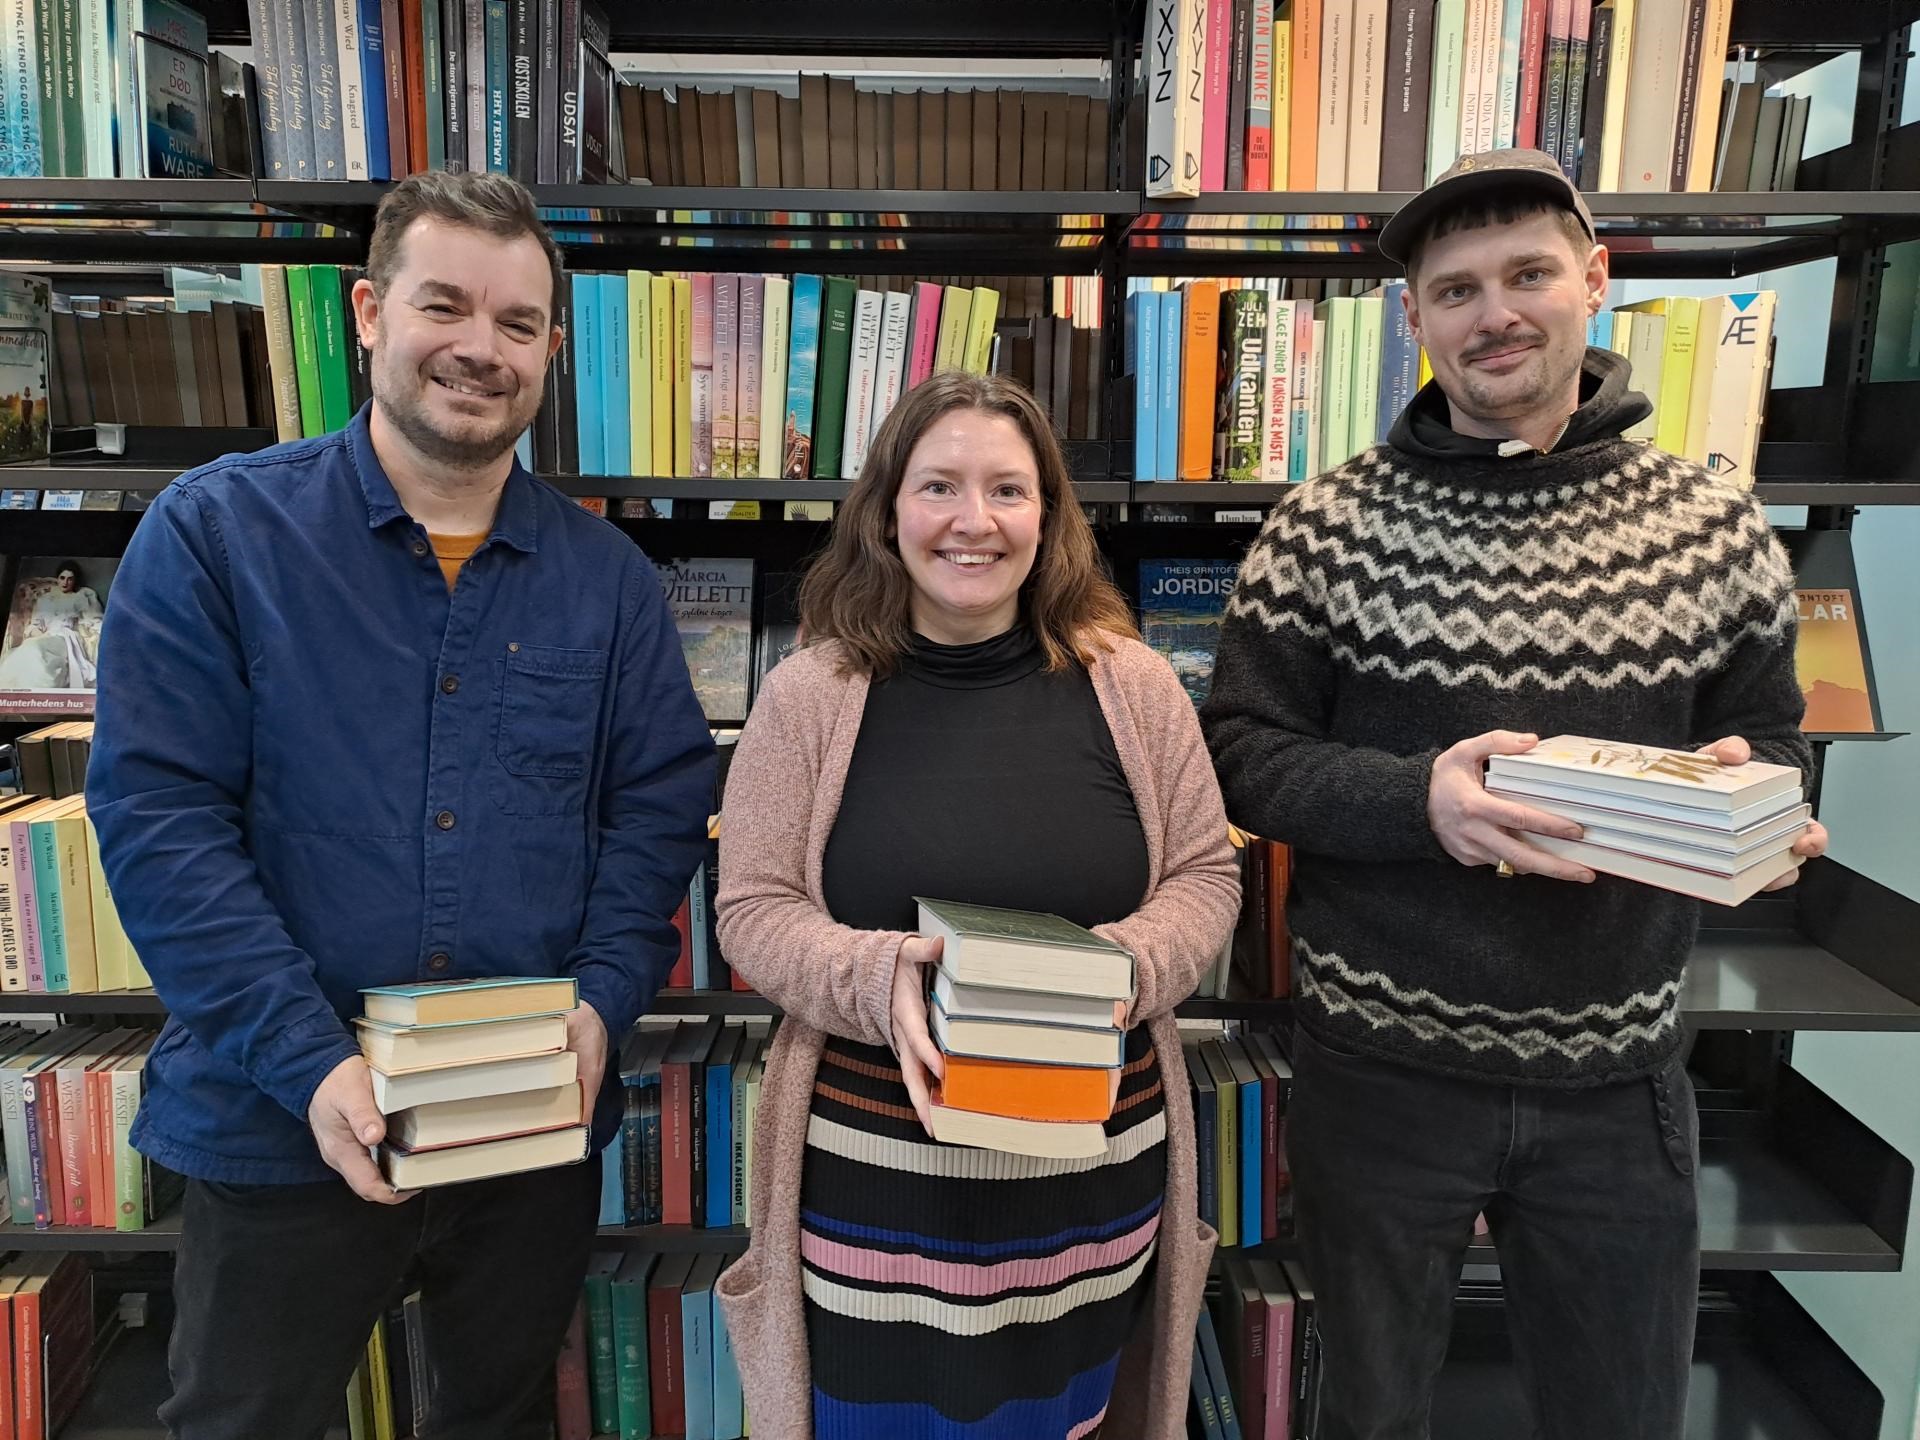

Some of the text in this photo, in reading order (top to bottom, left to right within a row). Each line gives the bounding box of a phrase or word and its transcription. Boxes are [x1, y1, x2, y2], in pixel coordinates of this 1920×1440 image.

[1332, 14, 1341, 35] Hanya
[1366, 14, 1375, 35] Hanya
[1406, 8, 1416, 32] Hanya
[1530, 11, 1540, 45] Samantha
[17, 30, 27, 73] LEVENDE
[173, 58, 186, 74] ER
[1254, 6, 1271, 101] YAN LIANKE
[1404, 33, 1414, 74] Yanagihara:
[20, 76, 28, 91] OG
[169, 75, 191, 94] DØD
[344, 24, 360, 130] Wied Knagsted
[515, 27, 530, 119] WIK KOSTSKOLEN
[1463, 44, 1479, 123] YOUNG INDIA
[1480, 44, 1495, 123] YOUNG INDIA
[1526, 70, 1535, 95] London
[1683, 77, 1692, 103] dengang
[286, 86, 305, 131] hjerteslag
[314, 86, 335, 131] hjerteslag
[448, 51, 459, 133] De store stjerners tid
[1402, 86, 1411, 113] paradis
[1501, 76, 1514, 128] JAMAICA
[1547, 73, 1560, 128] SCOTLAND
[261, 88, 281, 132] hjerteslag
[562, 91, 577, 147] UDSAT
[1564, 74, 1581, 170] SCOTLAND STREET
[1679, 112, 1688, 138] Sanguan
[22, 124, 31, 151] SYNG
[493, 90, 502, 166] HHV. FRSHWN
[161, 153, 205, 178] WARE
[267, 270, 279, 306] MARCIA
[716, 285, 729, 345] WILLETT
[742, 286, 754, 347] WILLETT
[1238, 312, 1267, 327] ZEH
[1241, 302, 1263, 312] JULI
[272, 309, 284, 350] WILLETT
[858, 301, 873, 361] WILLETT
[868, 314, 878, 349] MARCIA
[885, 302, 900, 362] WILLETT
[896, 316, 906, 350] MARCIA
[1720, 316, 1758, 346] Æ
[720, 365, 730, 391] særligt
[745, 366, 756, 392] særligt
[886, 370, 896, 387] Under
[1237, 338, 1263, 443] Udkanten
[695, 374, 709, 454] Syv sommerdage
[721, 396, 729, 412] sted
[746, 397, 755, 413] sted
[855, 369, 870, 456] Under nattens stjerner
[1297, 401, 1305, 415] DER
[1296, 417, 1304, 436] SIGER
[673, 567, 727, 583] MARCIA
[1151, 578, 1235, 595] JORDIS
[1163, 566, 1239, 575] THEIS ØRNTOFT
[681, 608, 733, 619] gyldne bæger
[0, 698, 85, 710] Munterhedens hus
[17, 834, 26, 846] Fay
[43, 832, 52, 844] Fay
[19, 847, 28, 871] Weldon
[45, 845, 54, 870] Weldon
[23, 893, 31, 906] Ikke
[0, 883, 18, 970] EN HUN-DJÆVELS DØD
[3, 1080, 18, 1121] WESSEL
[61, 1080, 74, 1122] WESSEL
[116, 1085, 129, 1128] WESSEL
[735, 1142, 743, 1207] IKKE AFSENDT
